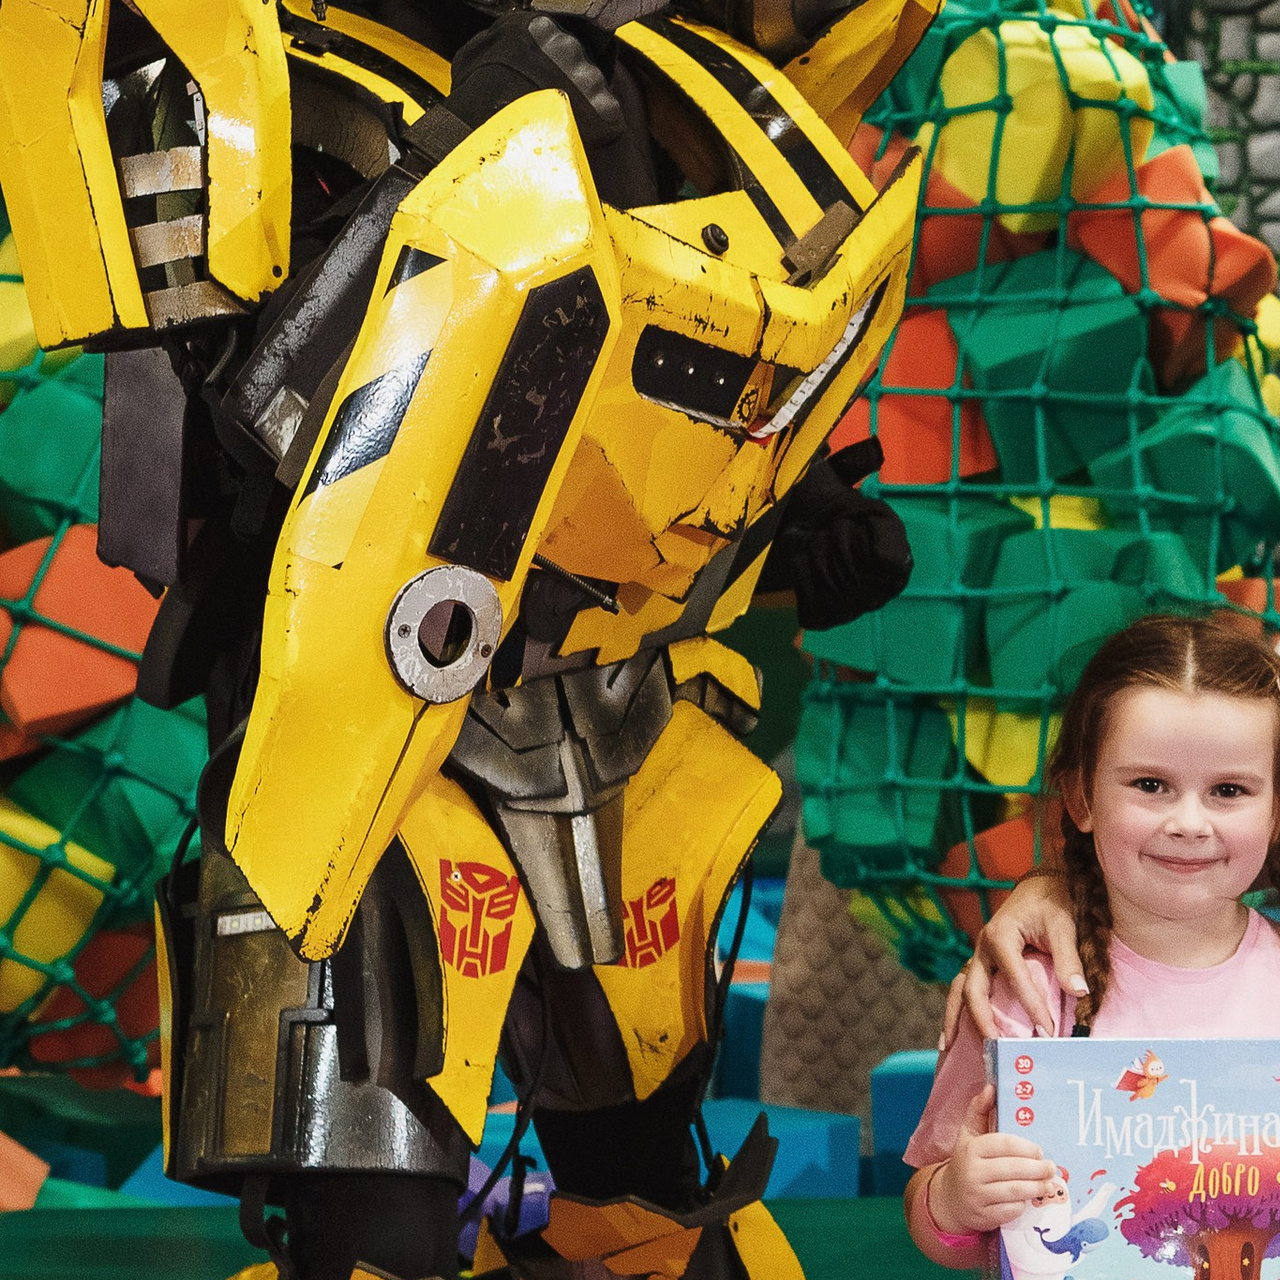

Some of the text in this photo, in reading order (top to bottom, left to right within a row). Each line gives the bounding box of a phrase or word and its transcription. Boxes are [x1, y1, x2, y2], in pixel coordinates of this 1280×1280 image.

[1016, 1084, 1032, 1094] 2-7
[1018, 1110, 1031, 1120] 6+
[1188, 1162, 1260, 1204] ДОБРО
